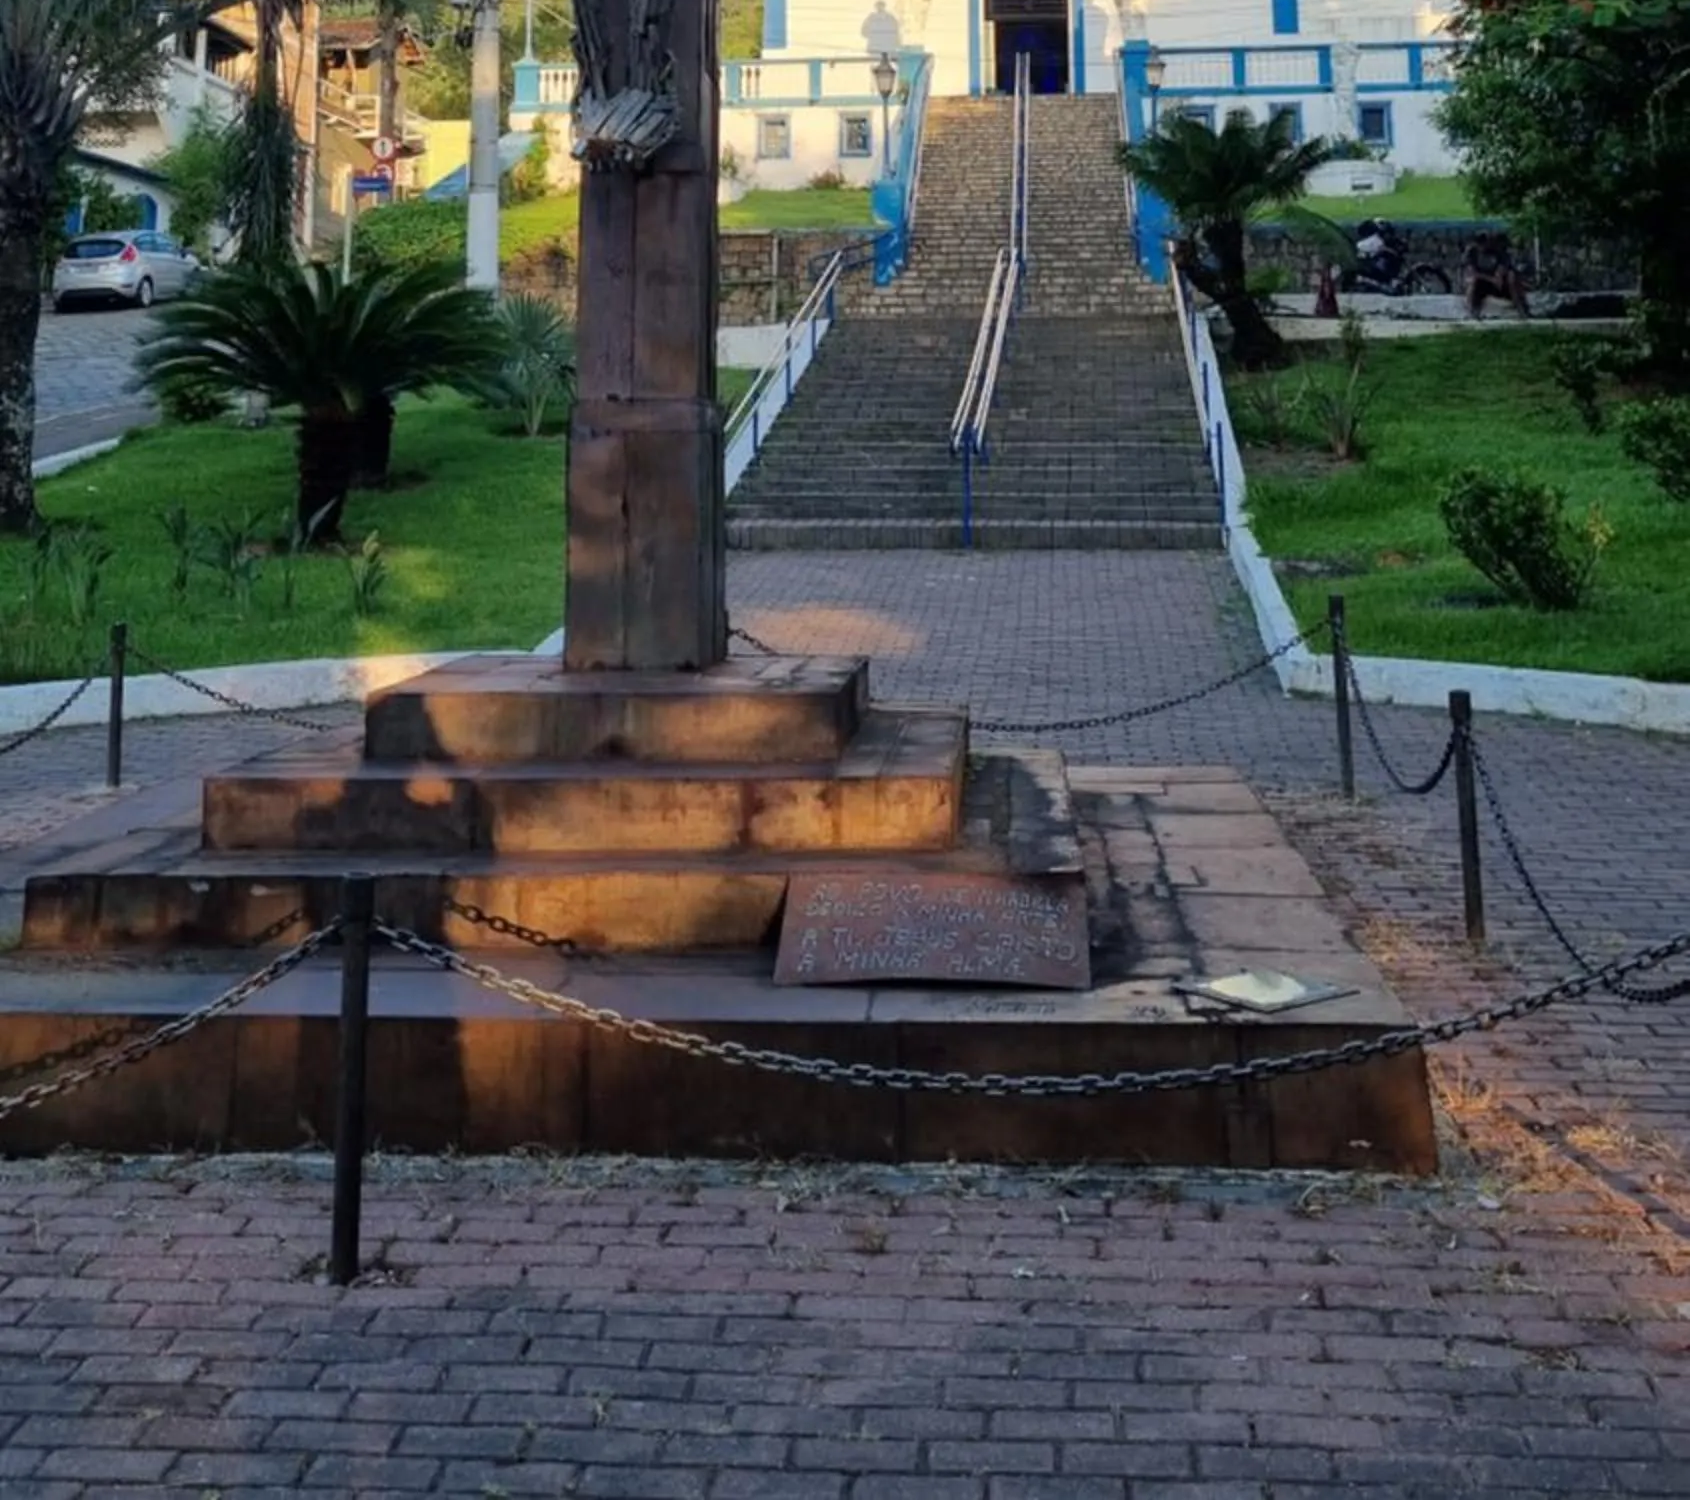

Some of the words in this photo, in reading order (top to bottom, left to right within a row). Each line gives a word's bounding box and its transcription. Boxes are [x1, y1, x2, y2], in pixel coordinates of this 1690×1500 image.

[801, 927, 818, 948] A
[873, 925, 959, 950] JESUS
[796, 952, 815, 973] A
[833, 950, 925, 972] MINHA
